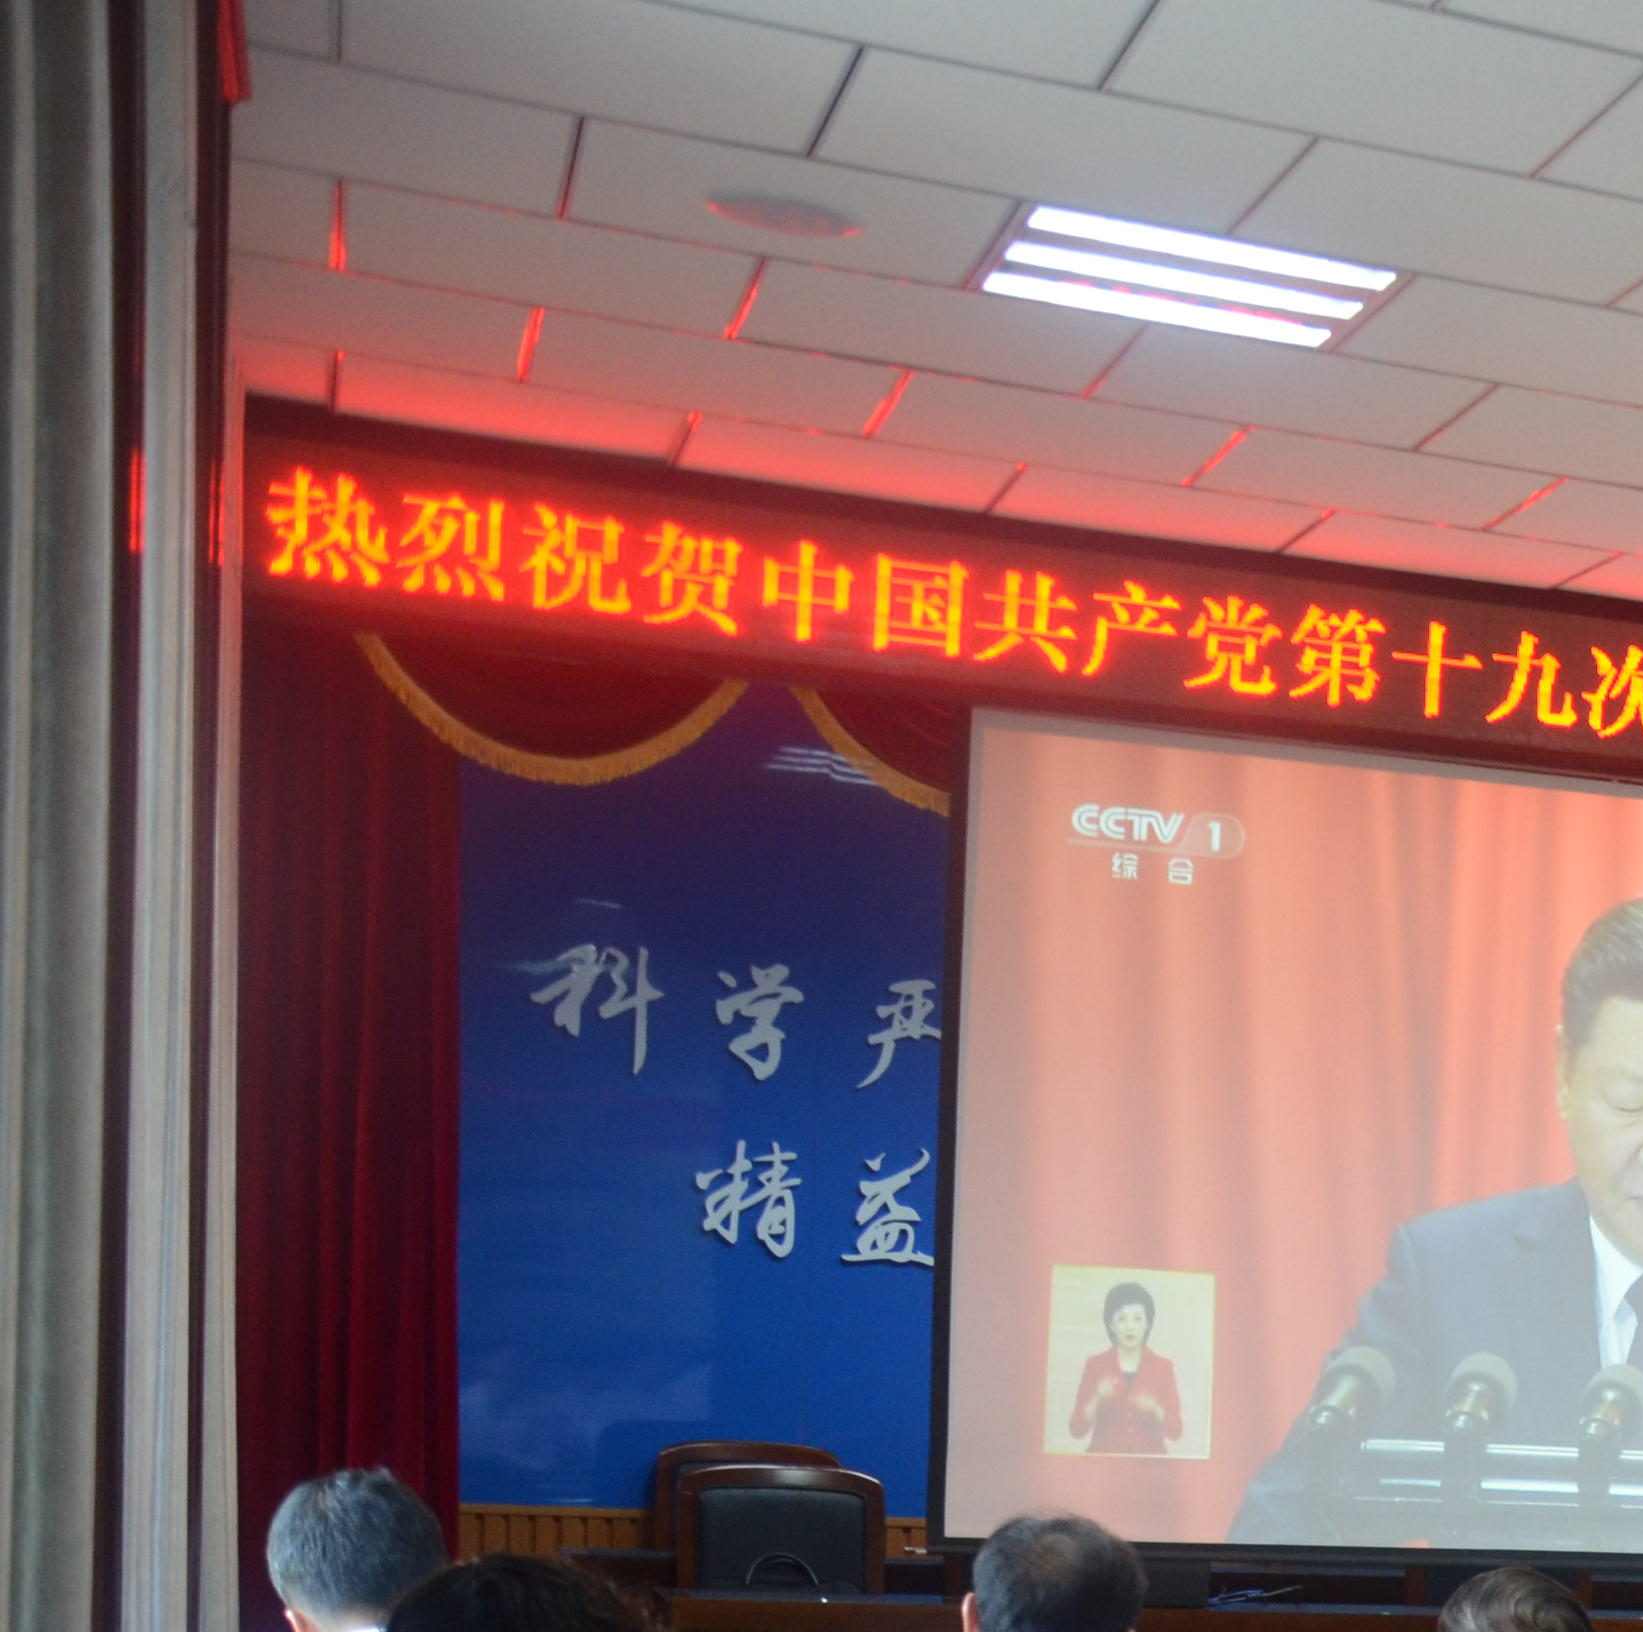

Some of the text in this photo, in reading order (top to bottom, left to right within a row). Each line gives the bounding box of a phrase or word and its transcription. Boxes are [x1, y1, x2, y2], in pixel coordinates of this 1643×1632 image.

[1071, 803, 1222, 852] CCTV 1
[1111, 852, 1194, 885] 综合
